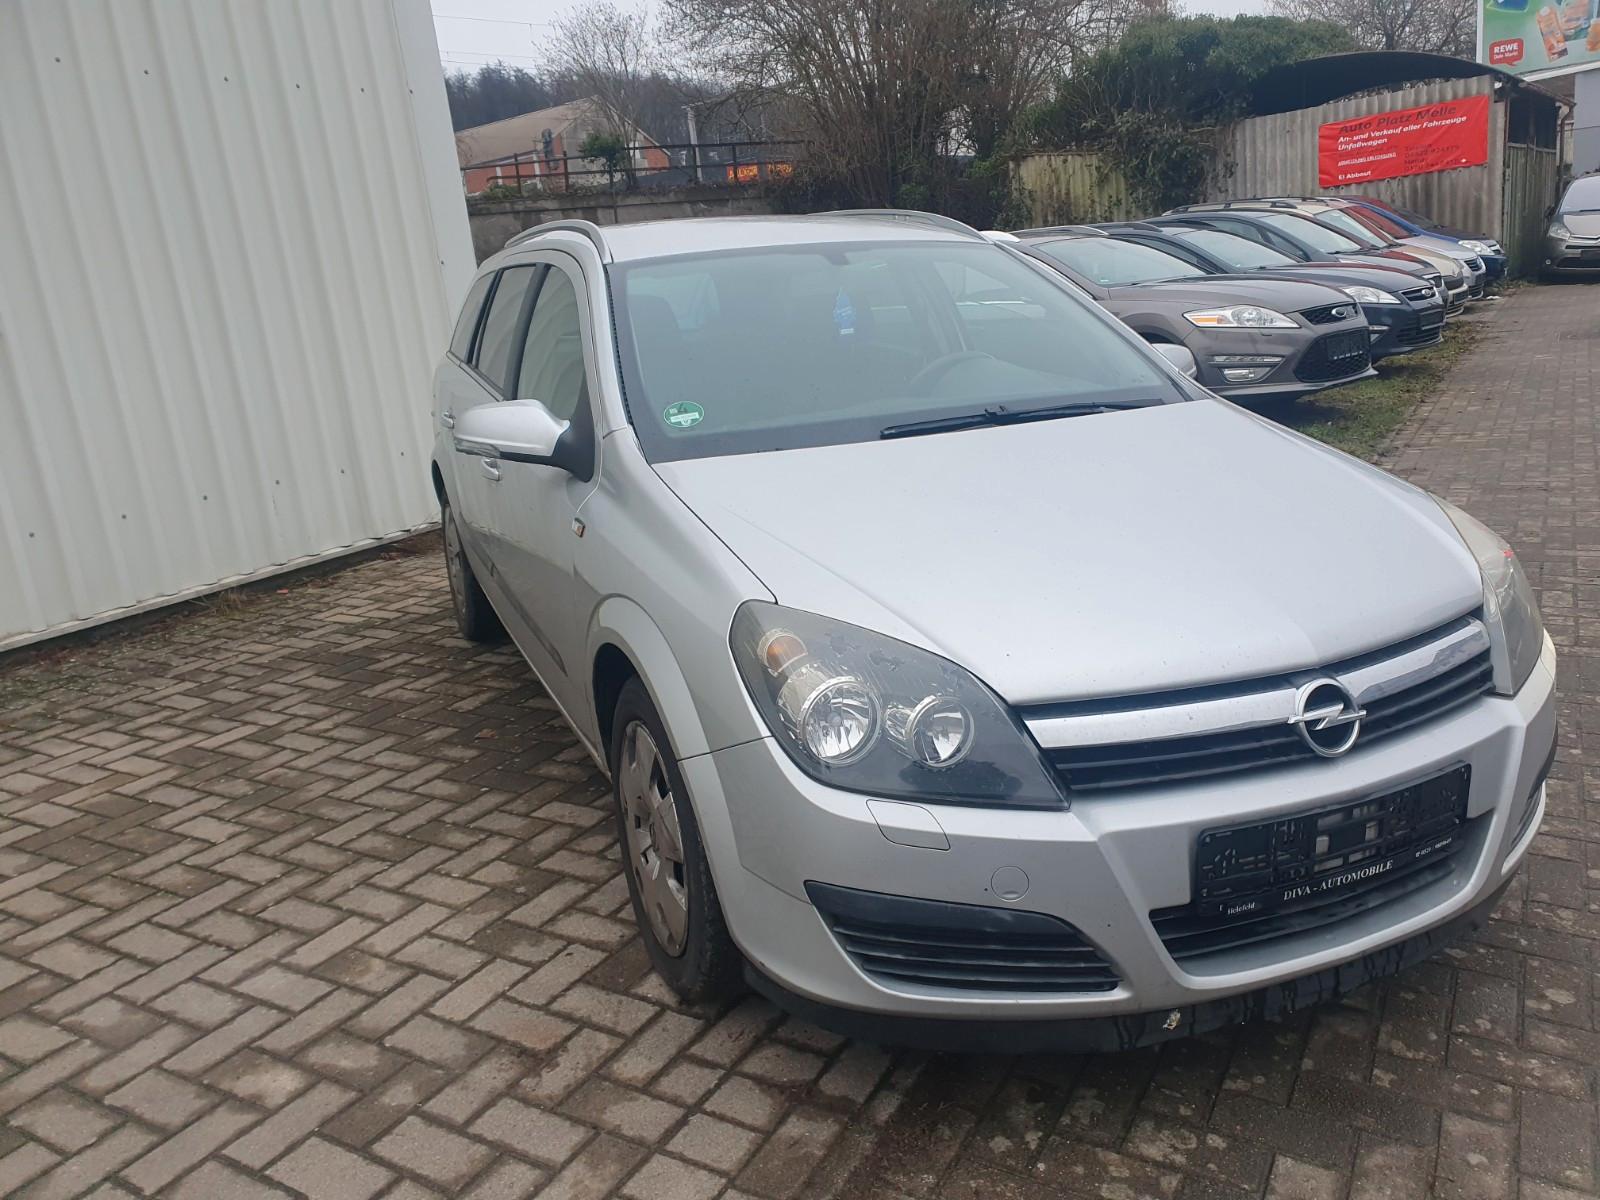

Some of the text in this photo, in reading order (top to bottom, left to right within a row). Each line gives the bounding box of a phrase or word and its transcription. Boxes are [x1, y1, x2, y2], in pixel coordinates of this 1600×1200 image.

[1494, 42, 1519, 53] REWE
[1339, 106, 1456, 133] Auto Platz Melle
[1353, 132, 1369, 140] und
[1370, 125, 1402, 138] Verkauf
[1402, 123, 1423, 132] aller
[1423, 115, 1467, 128] Fahrzeuge
[1338, 138, 1388, 151] Unfallwagen
[1283, 885, 1311, 901] DIVA
[1319, 859, 1394, 892] AUTOMOBILE
